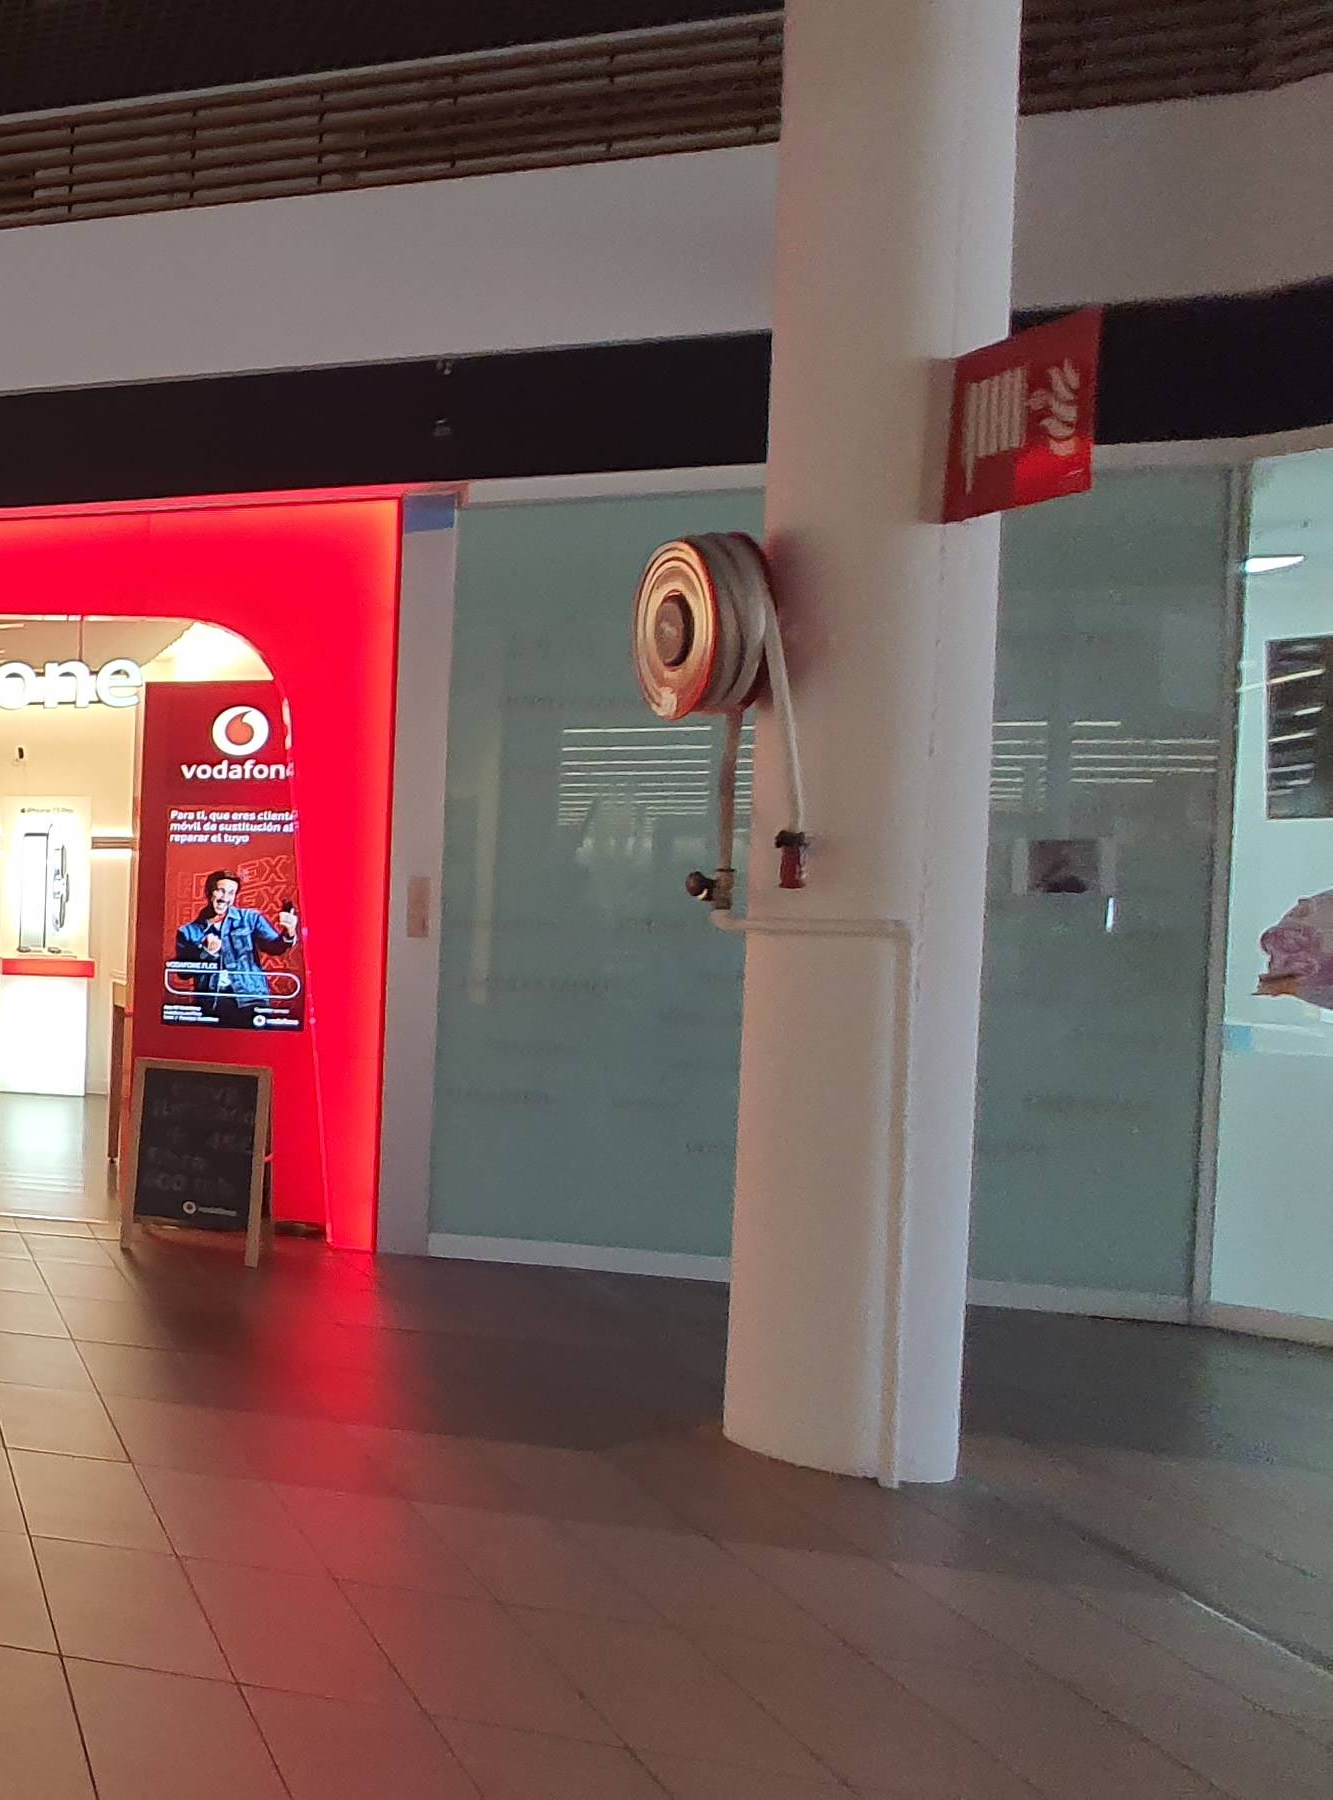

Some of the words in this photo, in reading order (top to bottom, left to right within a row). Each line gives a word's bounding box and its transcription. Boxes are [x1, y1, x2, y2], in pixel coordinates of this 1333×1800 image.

[170, 810, 196, 820] Para
[209, 812, 230, 822] que
[231, 812, 257, 821] eres
[169, 821, 201, 832] móvil
[203, 822, 217, 832] de
[218, 821, 281, 833] sustitución
[169, 833, 210, 843] reparar
[210, 833, 223, 843] el
[224, 833, 250, 846] tuyo
